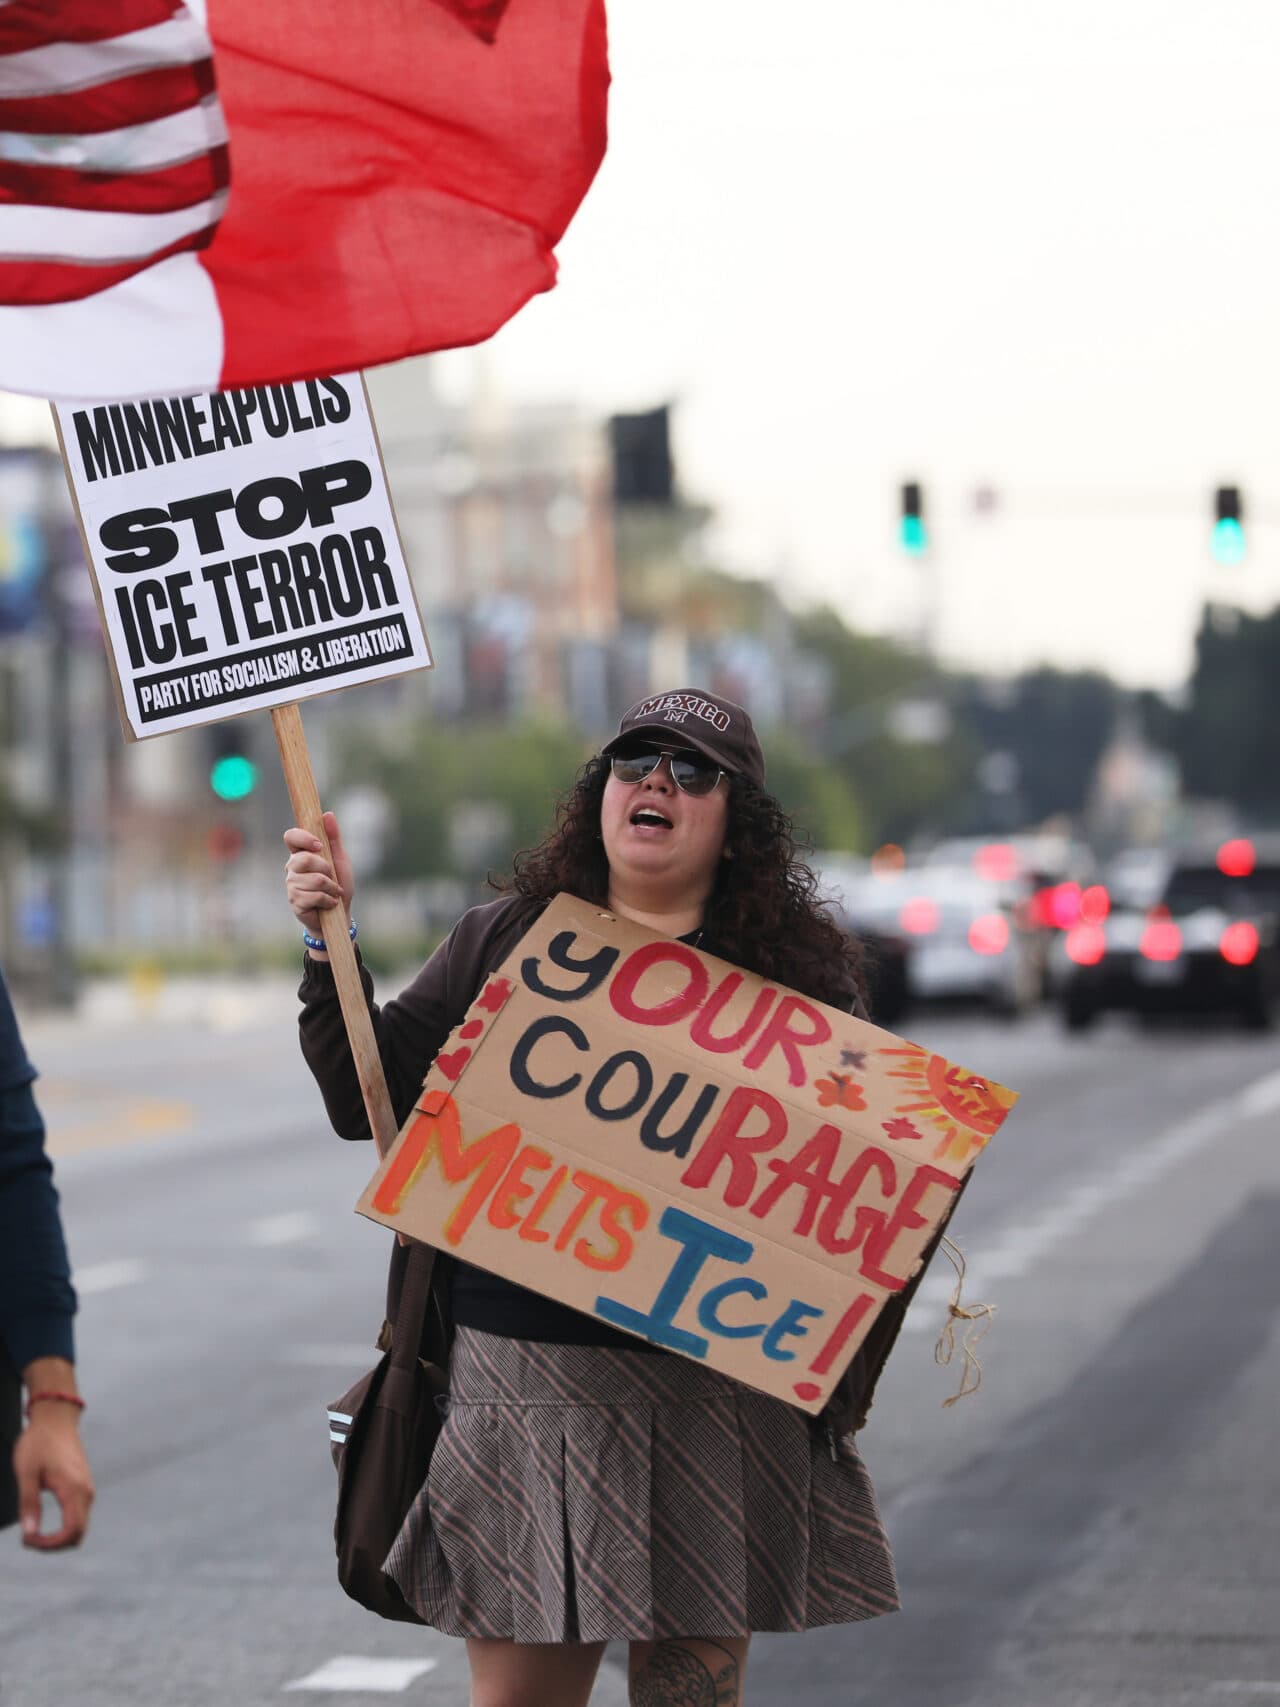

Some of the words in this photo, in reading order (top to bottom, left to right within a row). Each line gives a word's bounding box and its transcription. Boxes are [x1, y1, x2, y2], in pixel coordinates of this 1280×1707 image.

[73, 376, 351, 482] MINNEAPOLIS
[99, 460, 372, 573] STOP
[115, 571, 208, 669] ICE
[202, 526, 399, 645] TERROR
[140, 677, 195, 711] PARTY
[192, 667, 224, 700] FOR
[224, 650, 300, 692] SOCIALISM
[301, 647, 321, 672] &
[318, 624, 406, 669] LIBERATION
[634, 695, 730, 731] MEXICO
[664, 709, 688, 723] M
[371, 1091, 650, 1272] MELTS
[509, 1016, 962, 1290] COURAGE
